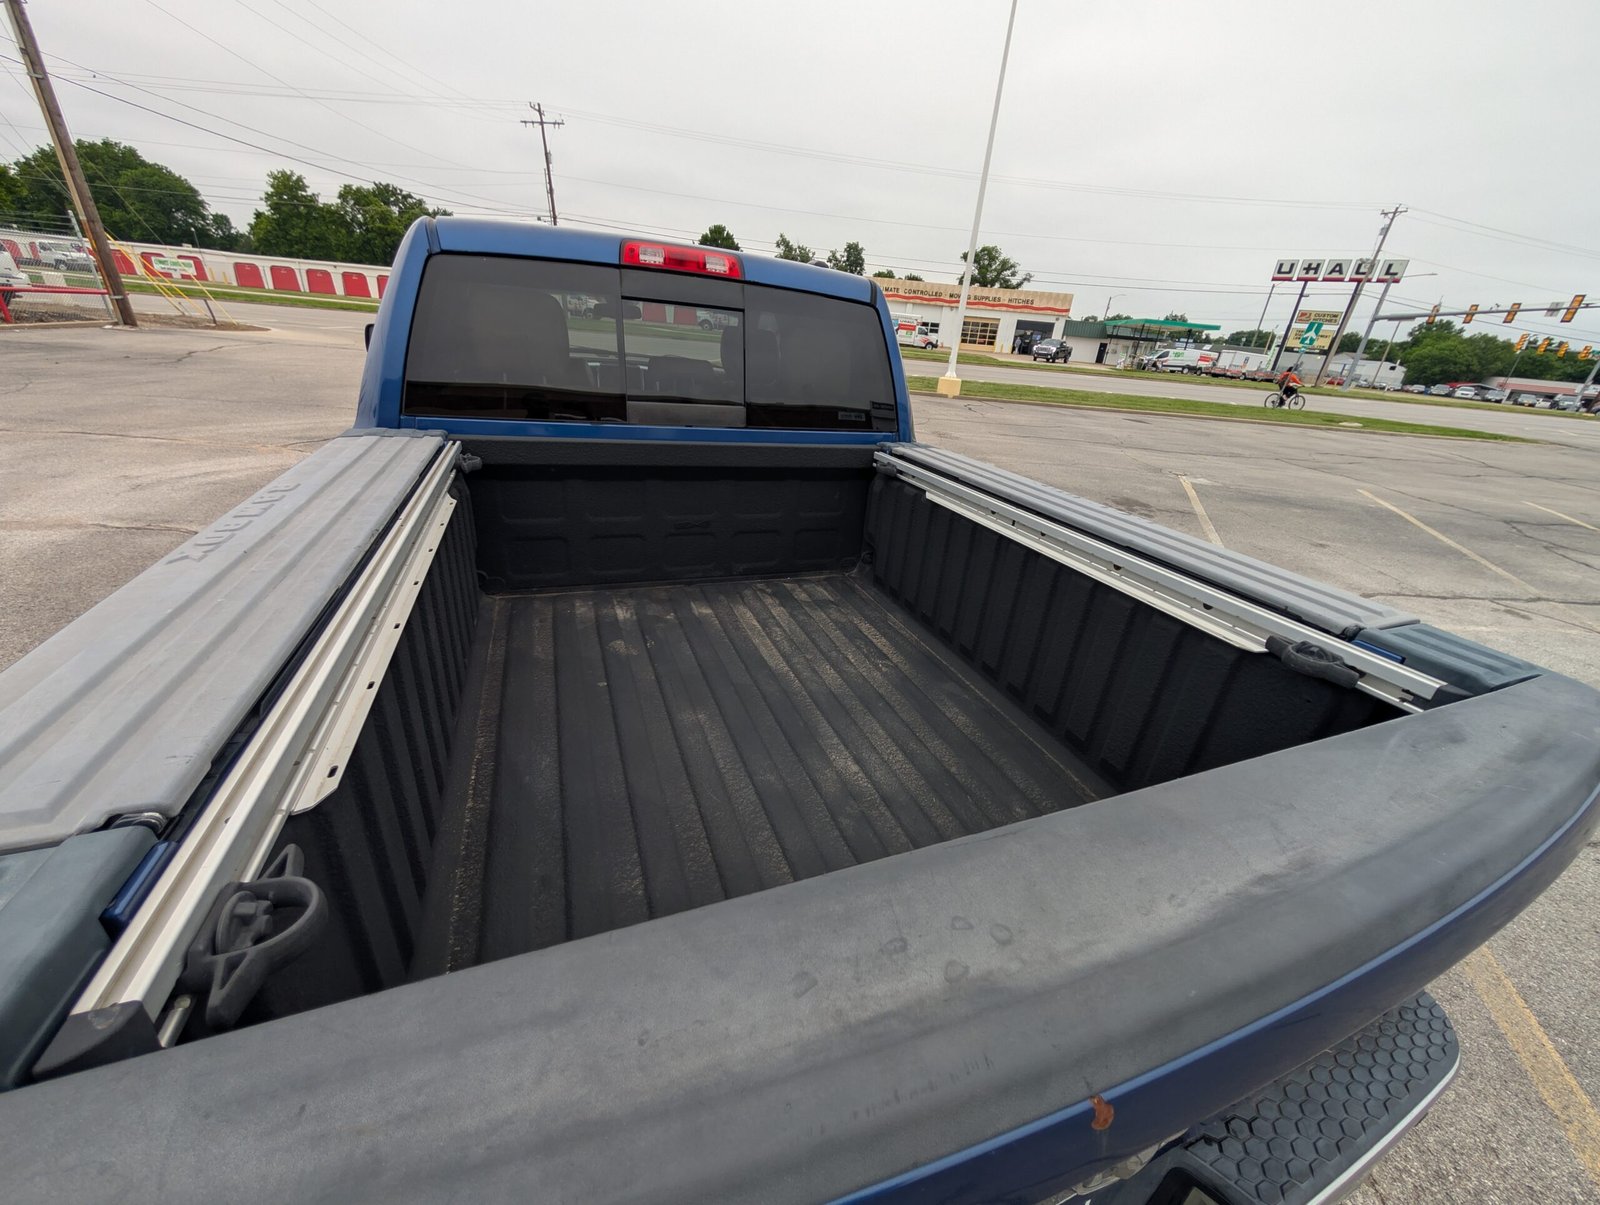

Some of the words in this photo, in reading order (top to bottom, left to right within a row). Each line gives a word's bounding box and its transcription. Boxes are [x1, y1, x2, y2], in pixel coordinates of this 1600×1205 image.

[904, 288, 943, 297] CONTROLLED
[974, 294, 1001, 302] SUPPLIES
[1008, 297, 1034, 305] HITCHES
